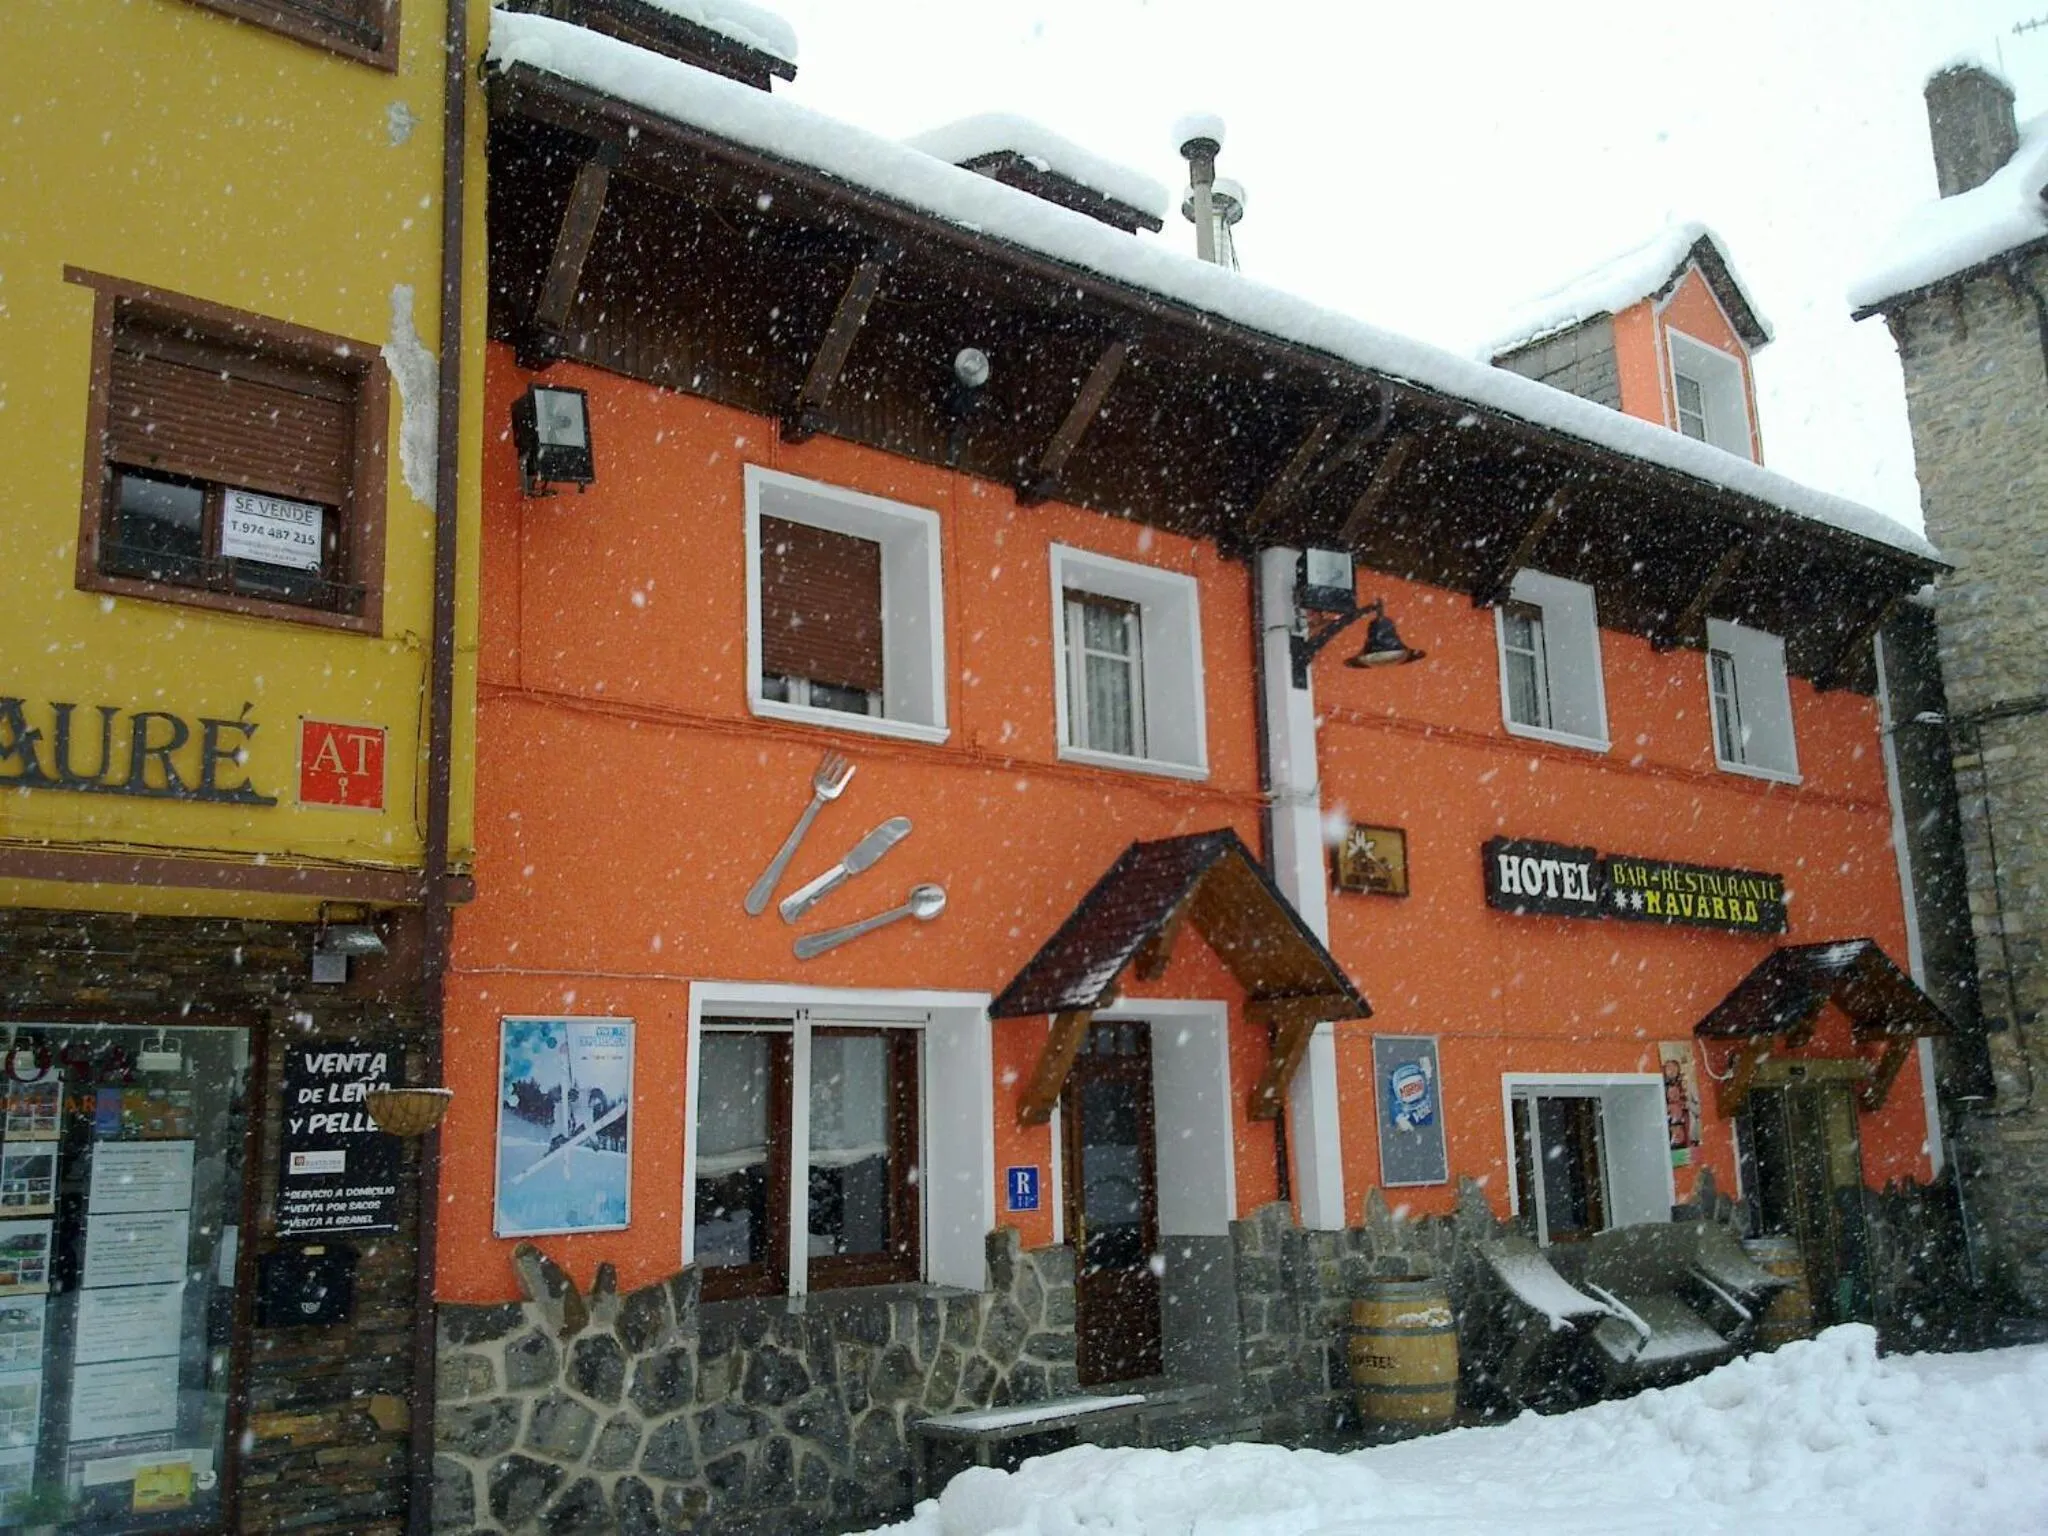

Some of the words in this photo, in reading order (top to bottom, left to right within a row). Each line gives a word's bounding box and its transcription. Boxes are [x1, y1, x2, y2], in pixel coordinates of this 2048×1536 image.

[235, 496, 254, 513] SE
[258, 500, 314, 524] VENDE
[308, 731, 381, 776] AT
[1498, 854, 1597, 902] HOTEL
[1612, 862, 1780, 902] BAR-RESTAURANTE
[1644, 889, 1760, 923] NAVARRA
[304, 1052, 388, 1074] VENTA
[298, 1087, 325, 1104] DE
[289, 1117, 304, 1135] Y
[290, 1189, 334, 1200] SERVICIO
[335, 1188, 343, 1198] A
[345, 1185, 396, 1197] DOMICILIO
[1015, 1171, 1031, 1195] R
[290, 1203, 324, 1213] VENTA
[326, 1202, 347, 1212] POR
[349, 1200, 381, 1211] SACOS
[289, 1217, 323, 1228] VENTA
[325, 1216, 334, 1226] A
